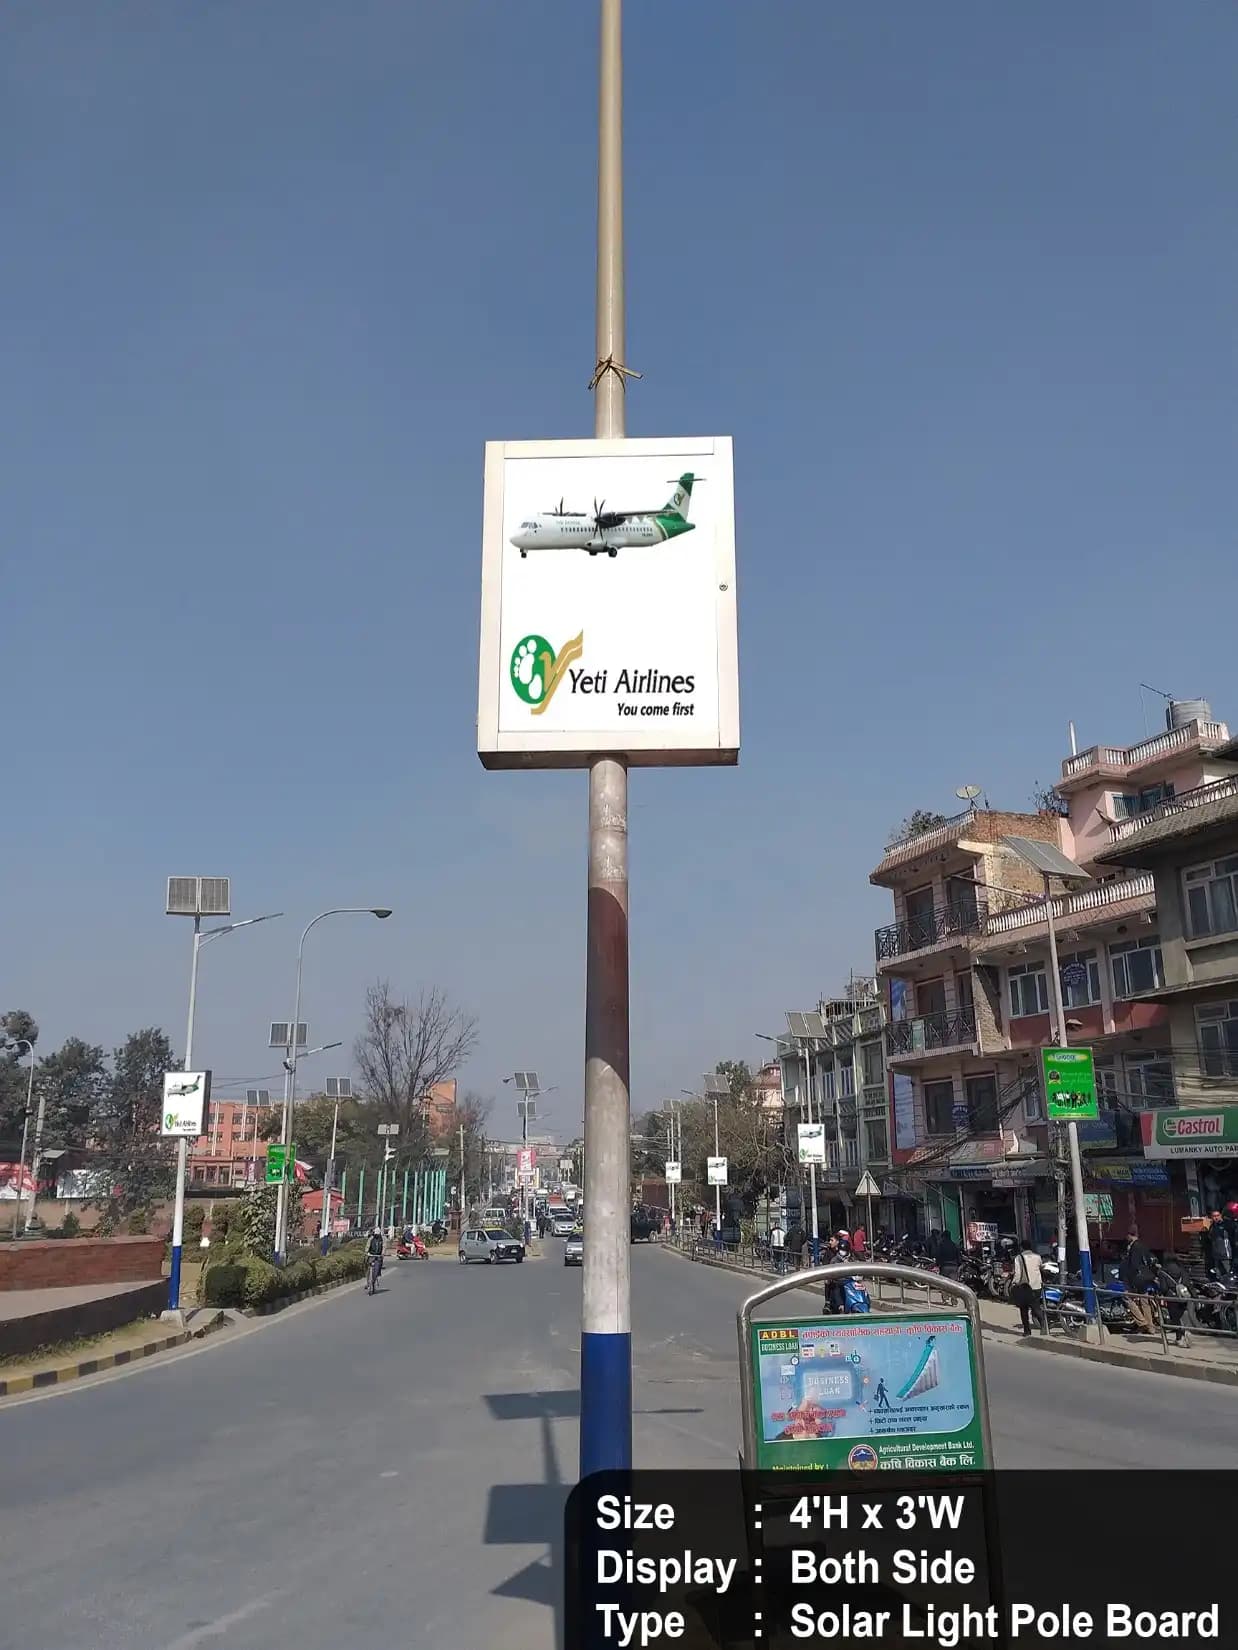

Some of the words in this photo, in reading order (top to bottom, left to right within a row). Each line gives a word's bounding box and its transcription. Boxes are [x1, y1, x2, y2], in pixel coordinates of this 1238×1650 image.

[568, 668, 608, 694] Yeti
[613, 668, 695, 694] Airlines
[617, 702, 638, 716] You
[640, 705, 670, 716] come
[672, 701, 695, 716] first
[1178, 1117, 1220, 1135] Castrol
[1204, 1145, 1223, 1153] AUTO
[761, 1342, 785, 1352] BUSINESS
[785, 1341, 799, 1351] LOAN
[807, 1375, 849, 1386] BUSINESS
[878, 1443, 911, 1455] Agricultural
[912, 1441, 948, 1454] Development
[948, 1441, 963, 1451] Bank
[963, 1440, 975, 1450] Ltd.
